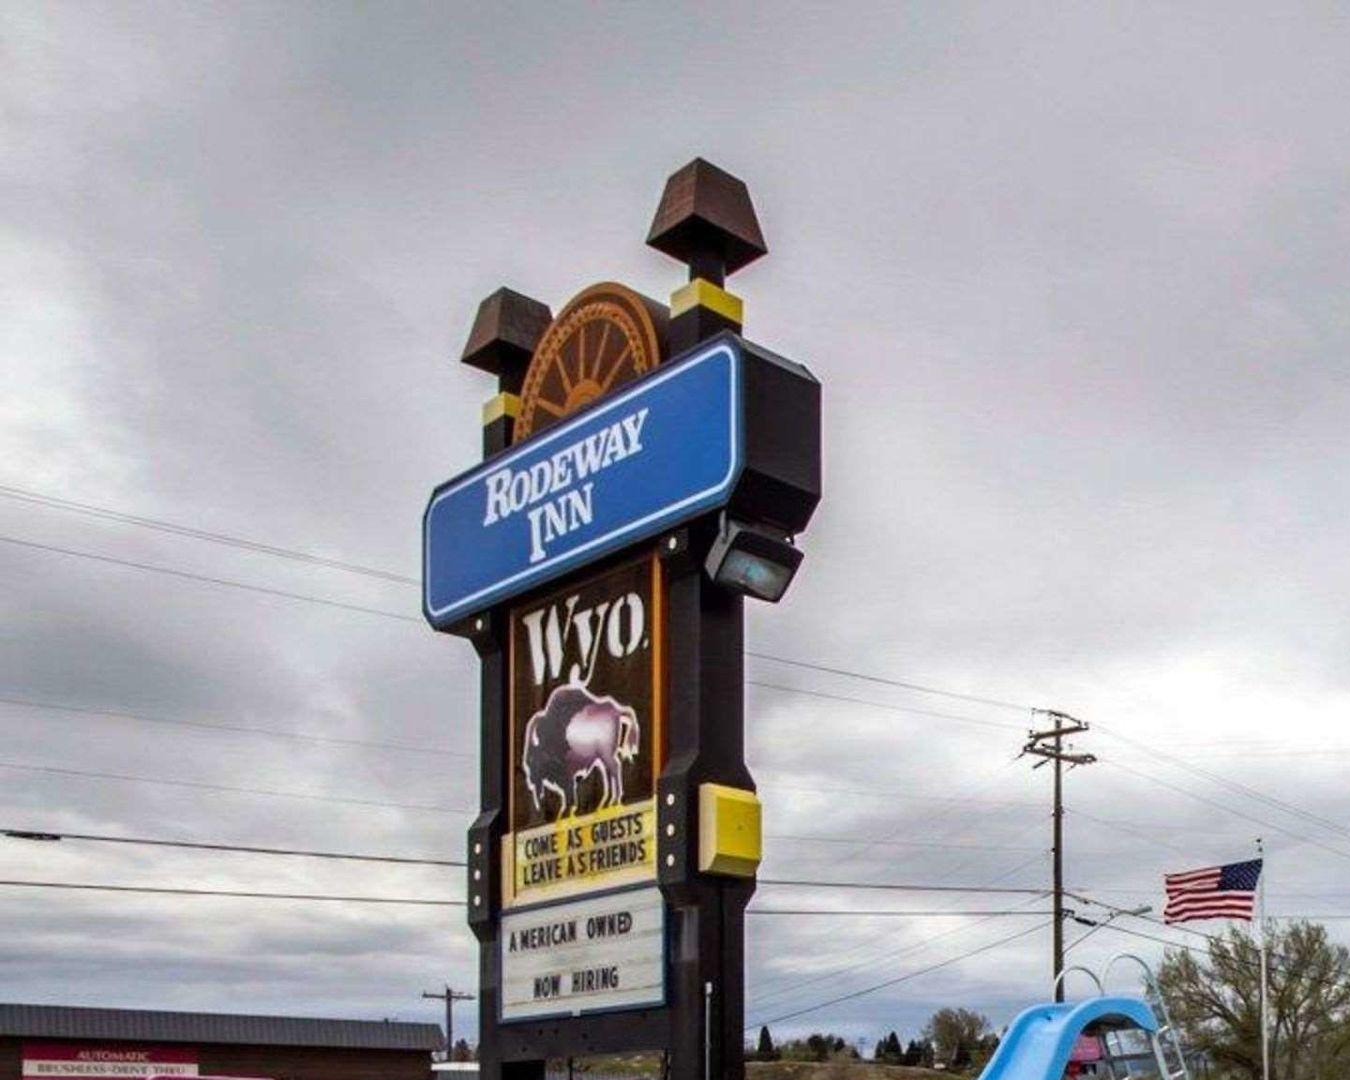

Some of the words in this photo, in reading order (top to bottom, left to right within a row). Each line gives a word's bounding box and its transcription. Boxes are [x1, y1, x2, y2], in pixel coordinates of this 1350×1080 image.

[483, 408, 649, 527] RODEWAY
[528, 482, 594, 563] INN
[525, 834, 558, 859] COME
[567, 827, 583, 848] AS
[591, 813, 643, 843] GUESTS
[524, 861, 562, 885] LEAVE
[568, 852, 586, 877] AS
[589, 840, 646, 872] FRIENDS
[509, 920, 577, 952] AMERICAN
[587, 911, 633, 938] OWNED
[534, 974, 561, 998] NOW
[572, 966, 619, 993] HIRING
[76, 1051, 149, 1061] AUTOMATIC
